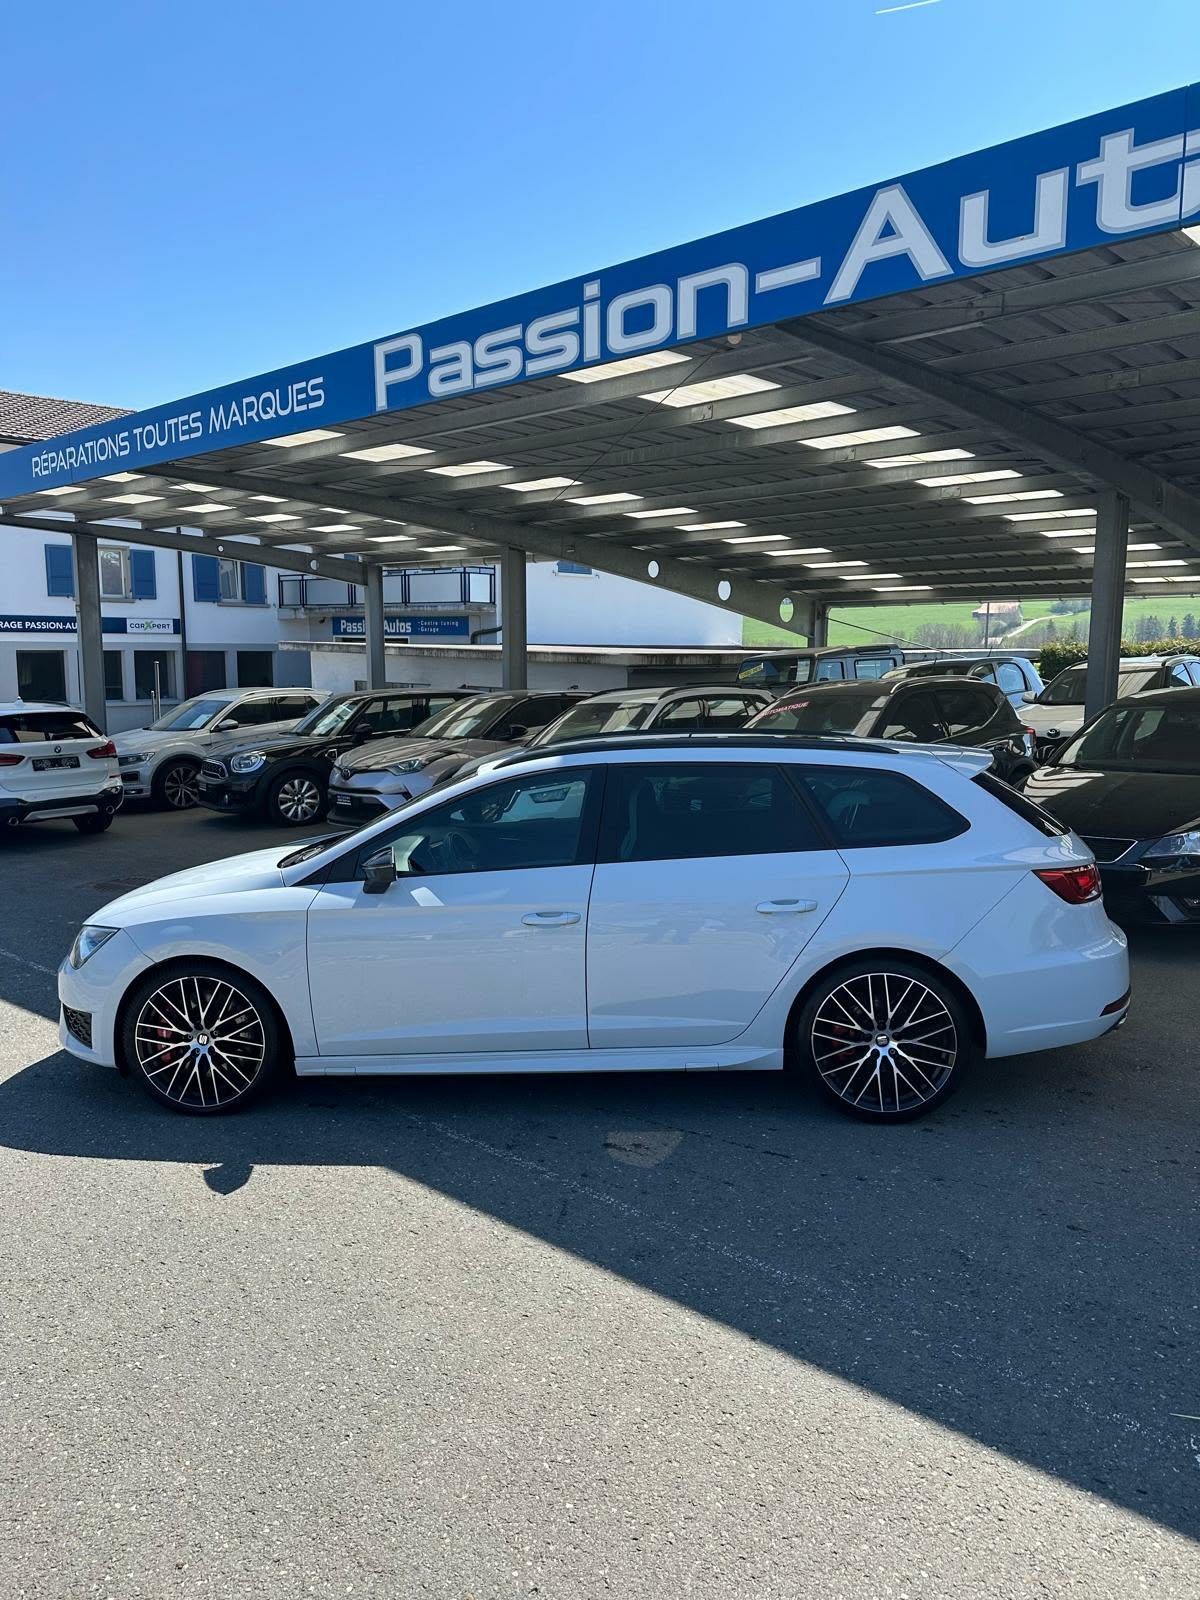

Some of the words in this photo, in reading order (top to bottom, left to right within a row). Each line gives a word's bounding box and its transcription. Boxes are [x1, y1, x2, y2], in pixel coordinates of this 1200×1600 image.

[31, 431, 130, 478] RÉPARATIONS
[133, 411, 202, 452] TOUTES
[208, 376, 325, 434] MARQUES
